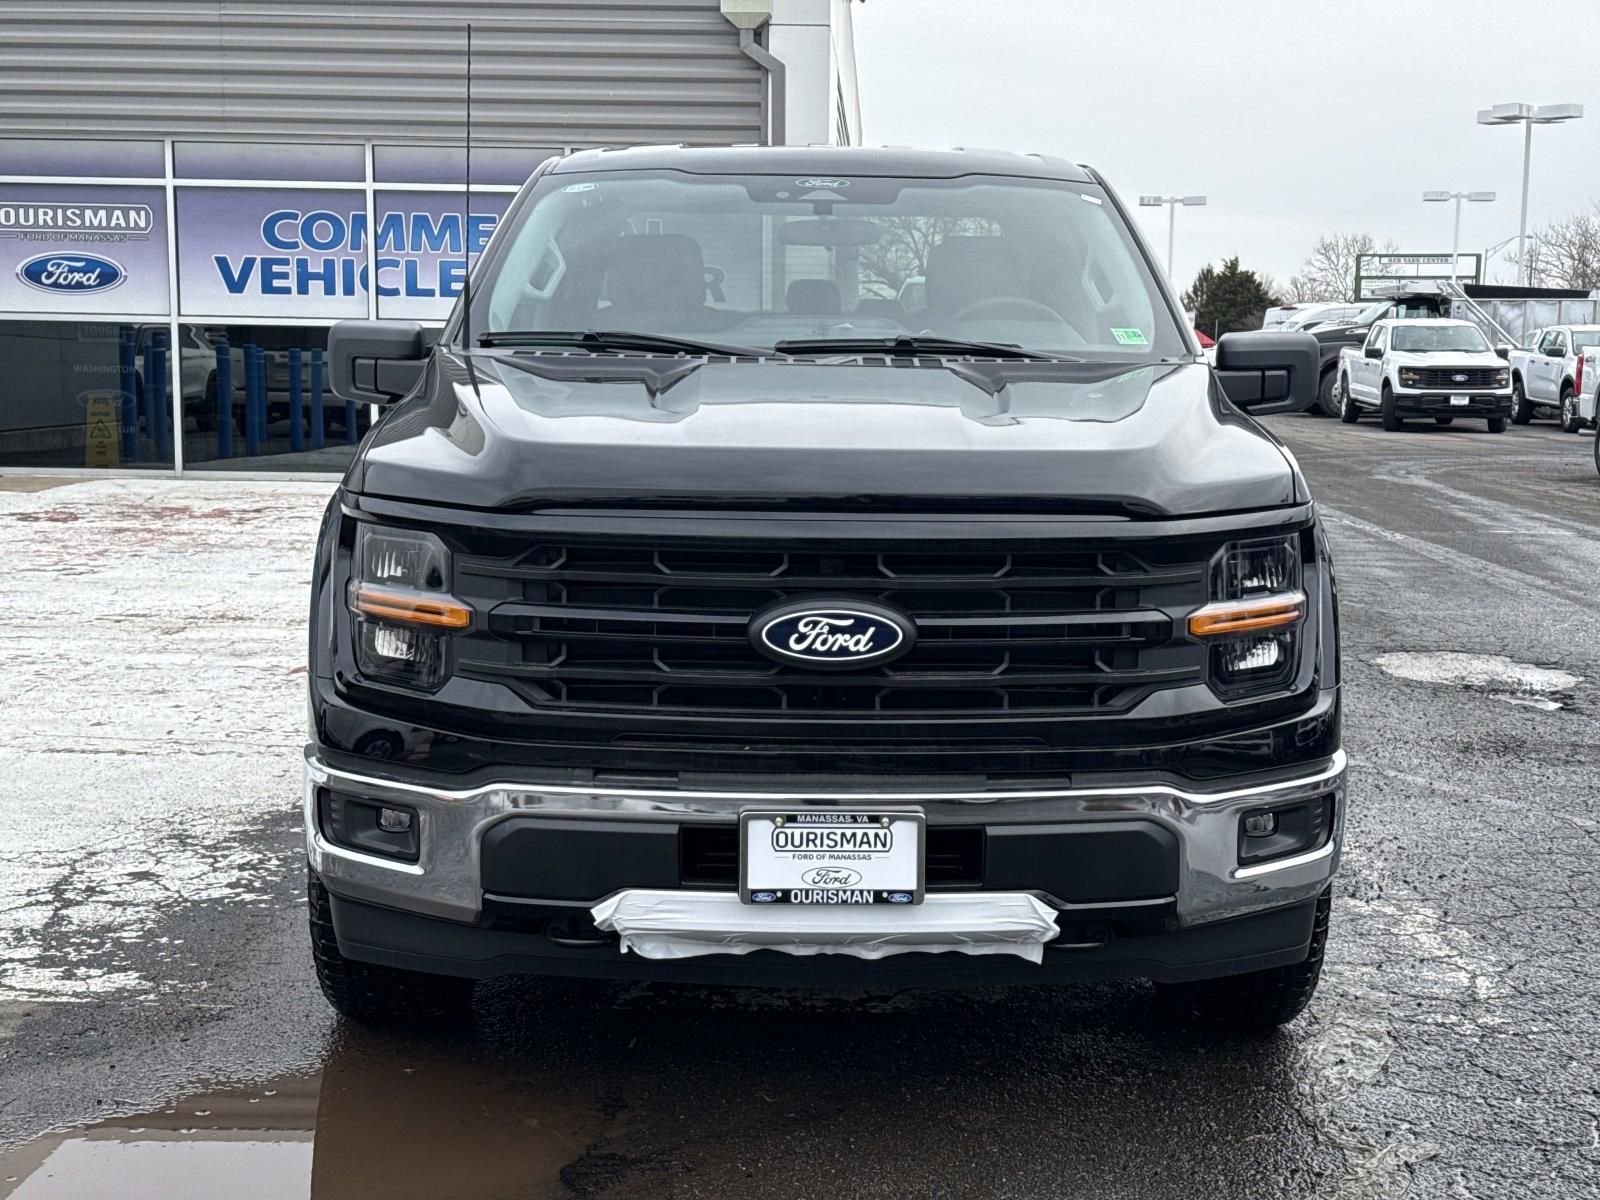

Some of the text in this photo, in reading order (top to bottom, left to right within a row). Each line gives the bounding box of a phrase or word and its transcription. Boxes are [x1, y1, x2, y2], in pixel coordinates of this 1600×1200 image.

[0, 208, 146, 228] OURISMAN
[20, 232, 49, 240] FORD
[69, 233, 127, 242] MANASSAS
[41, 260, 101, 285] Ford
[73, 364, 136, 374] WASHINGTON
[789, 616, 876, 652] Ford
[856, 815, 869, 823] VA
[775, 831, 888, 849] OURISMAN
[792, 853, 872, 861] FORD OF MANASSAS
[811, 868, 852, 885] Ford
[790, 889, 874, 904] OURISMAN
